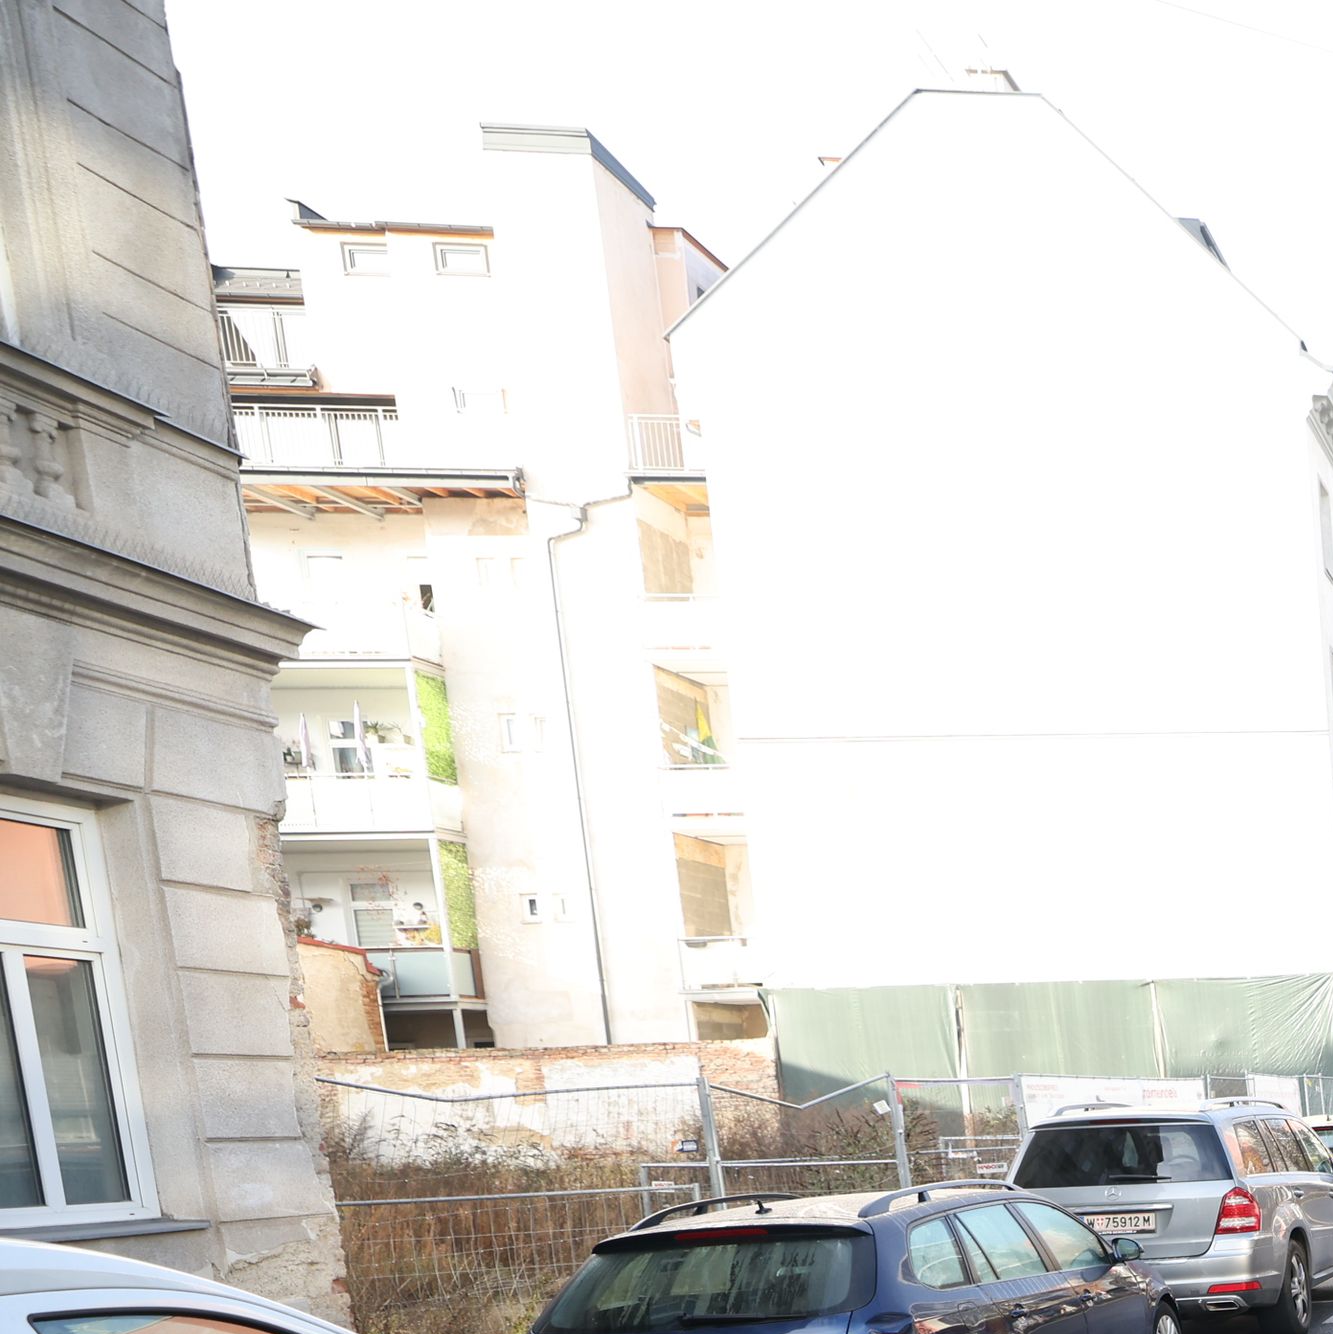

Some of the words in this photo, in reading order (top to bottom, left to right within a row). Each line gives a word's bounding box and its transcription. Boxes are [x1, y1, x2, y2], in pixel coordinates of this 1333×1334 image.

[1087, 1217, 1096, 1229] W
[1105, 1216, 1140, 1229] 75912
[1143, 1215, 1151, 1227] M
